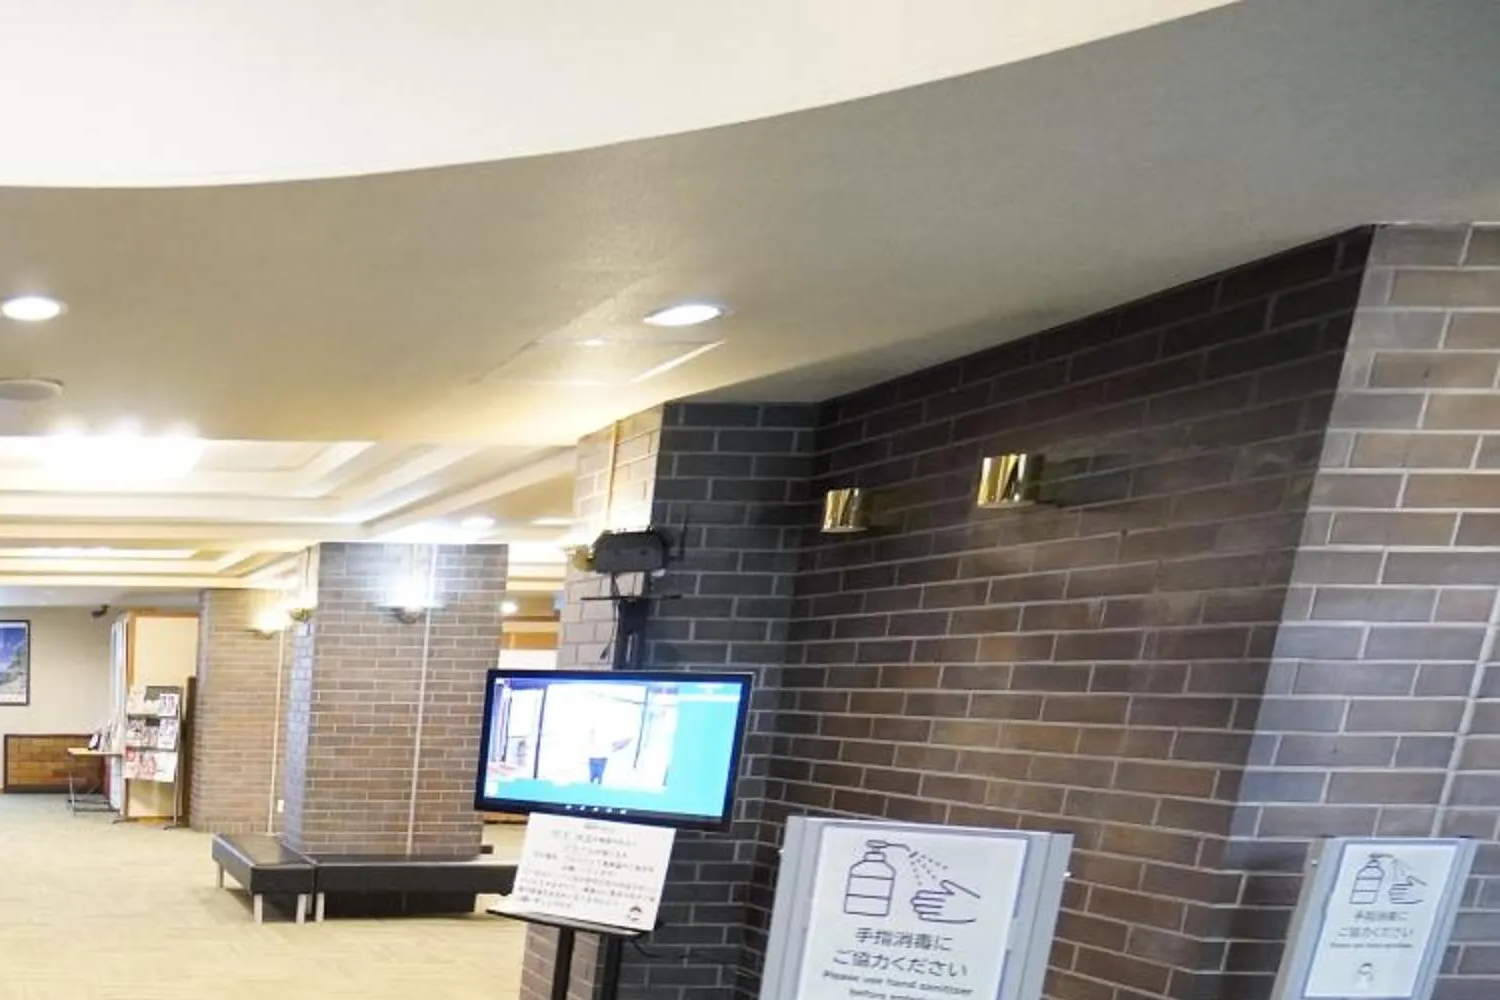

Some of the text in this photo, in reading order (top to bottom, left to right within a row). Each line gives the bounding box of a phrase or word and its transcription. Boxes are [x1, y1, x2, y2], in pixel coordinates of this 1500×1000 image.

[855, 927, 954, 951] 手指消毒に
[832, 949, 968, 977] ご協力ください
